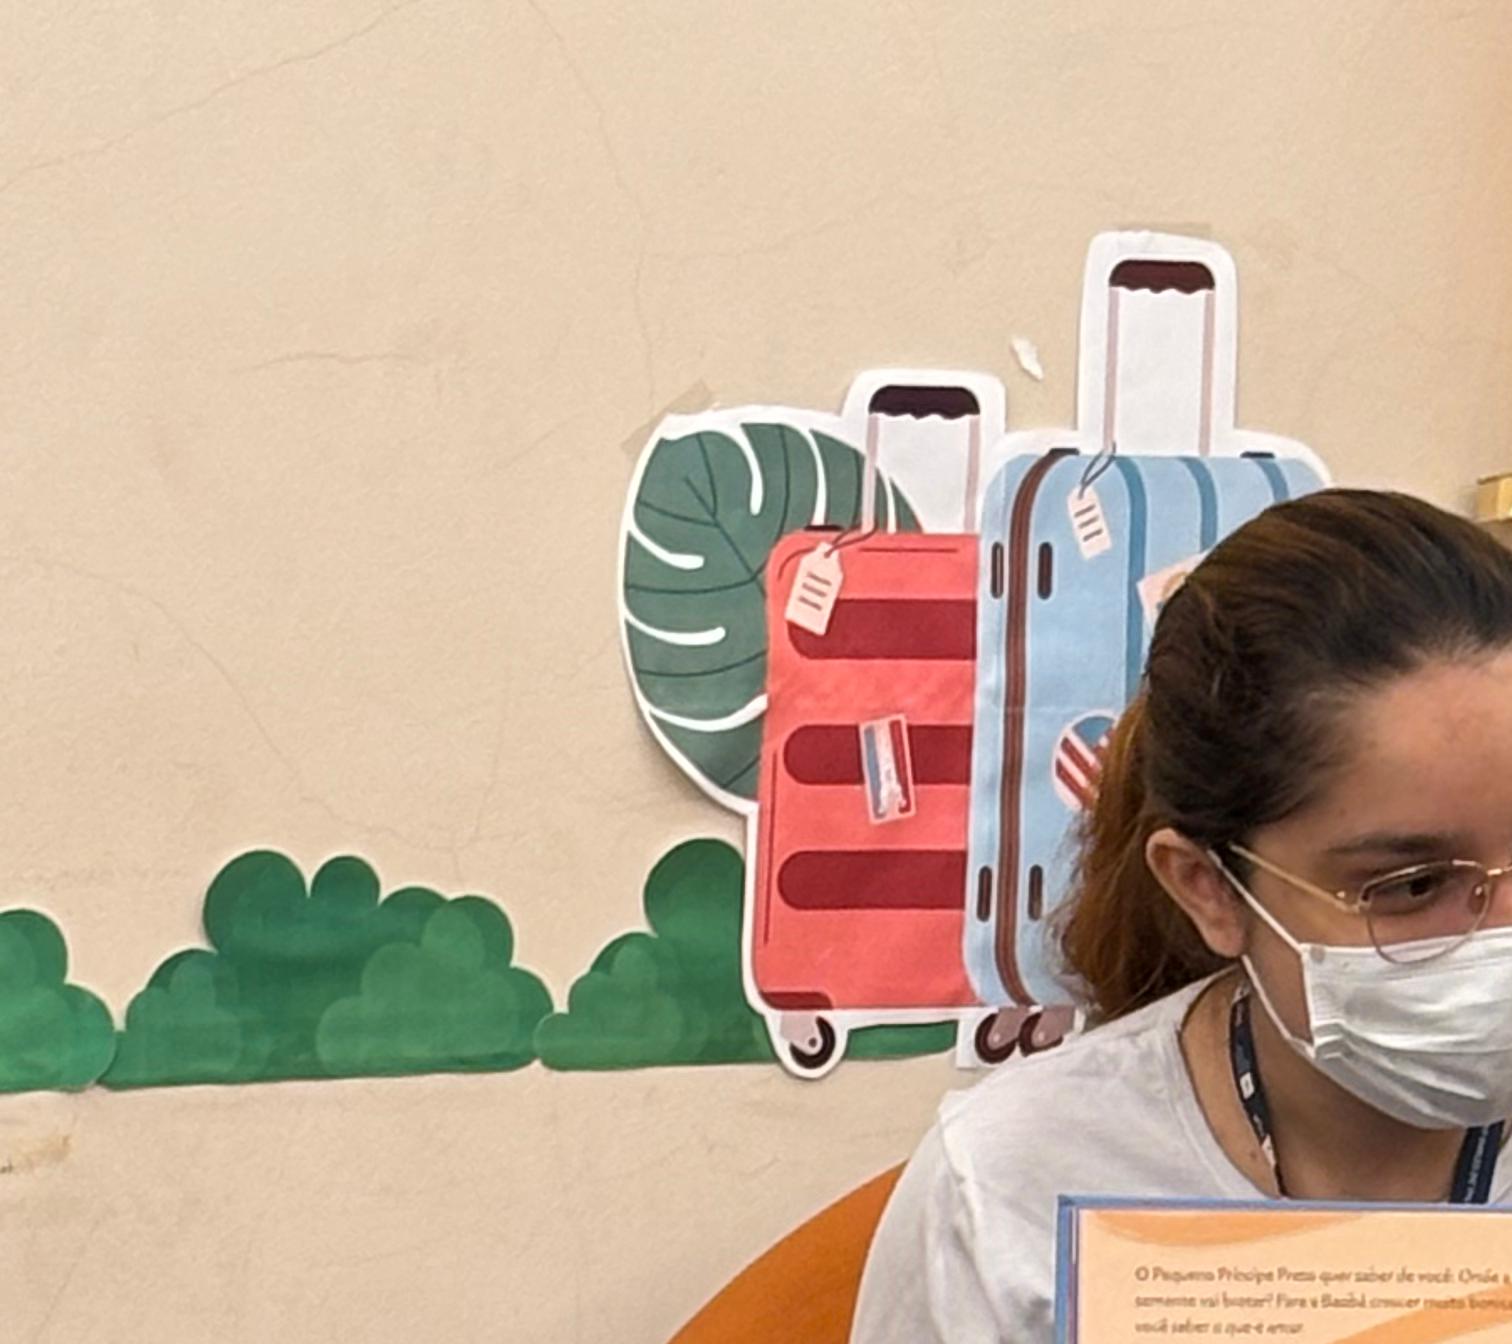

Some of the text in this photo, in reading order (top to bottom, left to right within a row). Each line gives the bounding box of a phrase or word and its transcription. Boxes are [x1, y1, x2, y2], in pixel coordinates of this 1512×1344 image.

[1134, 1266, 1149, 1281] O
[1217, 1267, 1273, 1285] Príncipe
[1397, 1268, 1415, 1282] de
[1200, 1296, 1220, 1308] vai
[1135, 1319, 1168, 1332] você
